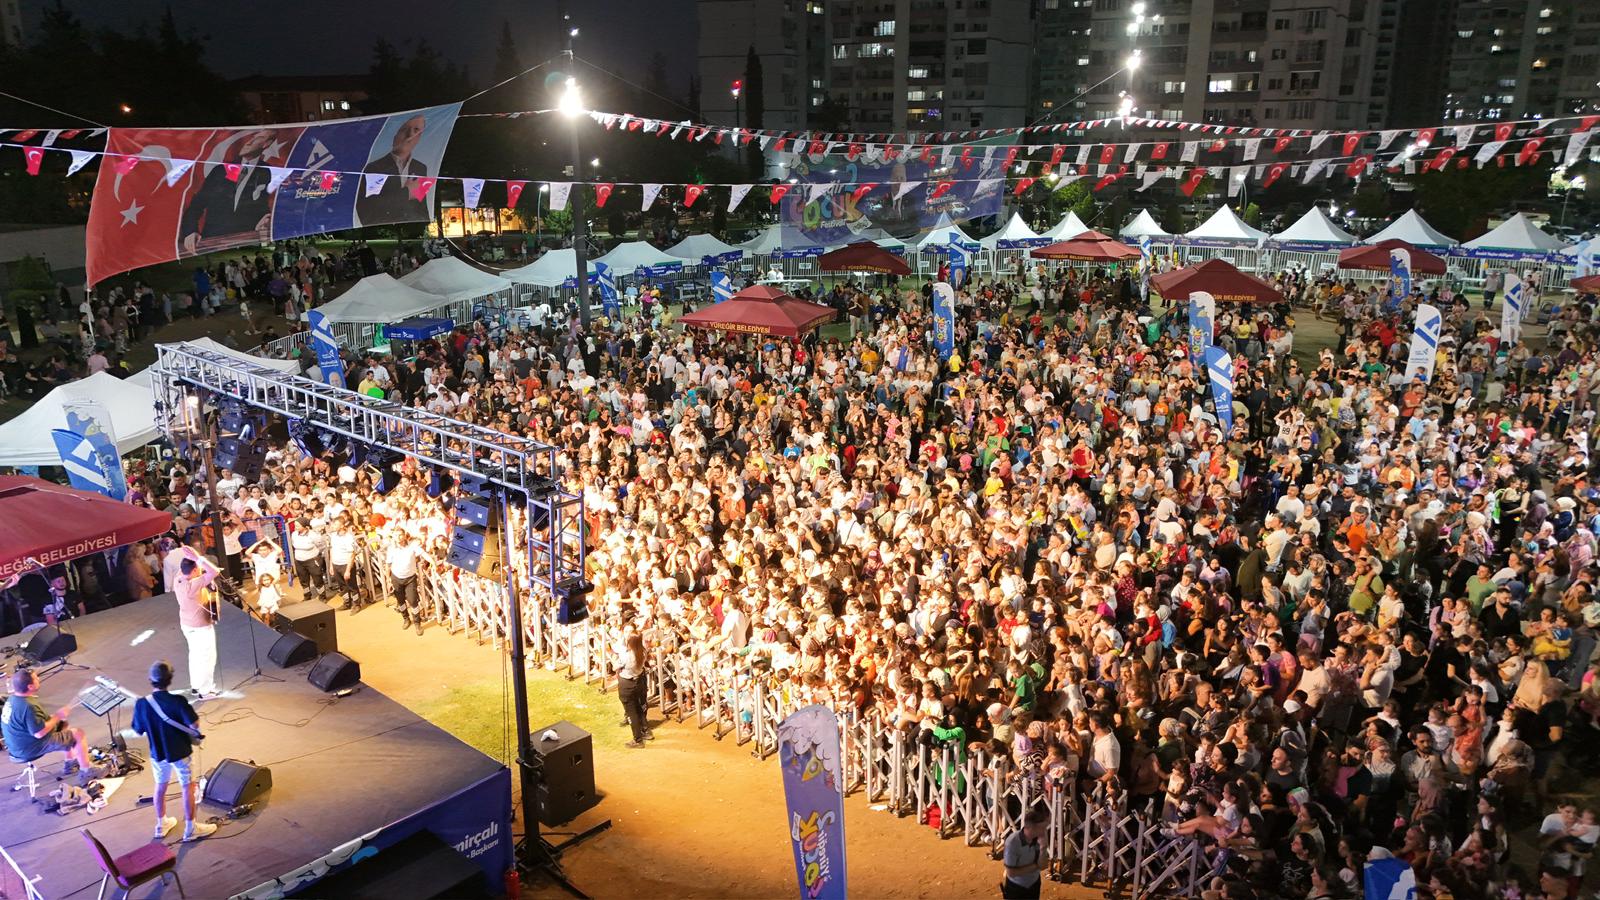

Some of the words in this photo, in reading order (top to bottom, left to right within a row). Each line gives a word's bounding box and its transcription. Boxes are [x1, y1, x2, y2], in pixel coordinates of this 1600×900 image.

[736, 324, 771, 334] BELEDİYESİ
[40, 532, 116, 564] BELEDİYESİ
[450, 821, 499, 852] mirçalı
[470, 838, 499, 859] Başkanı
